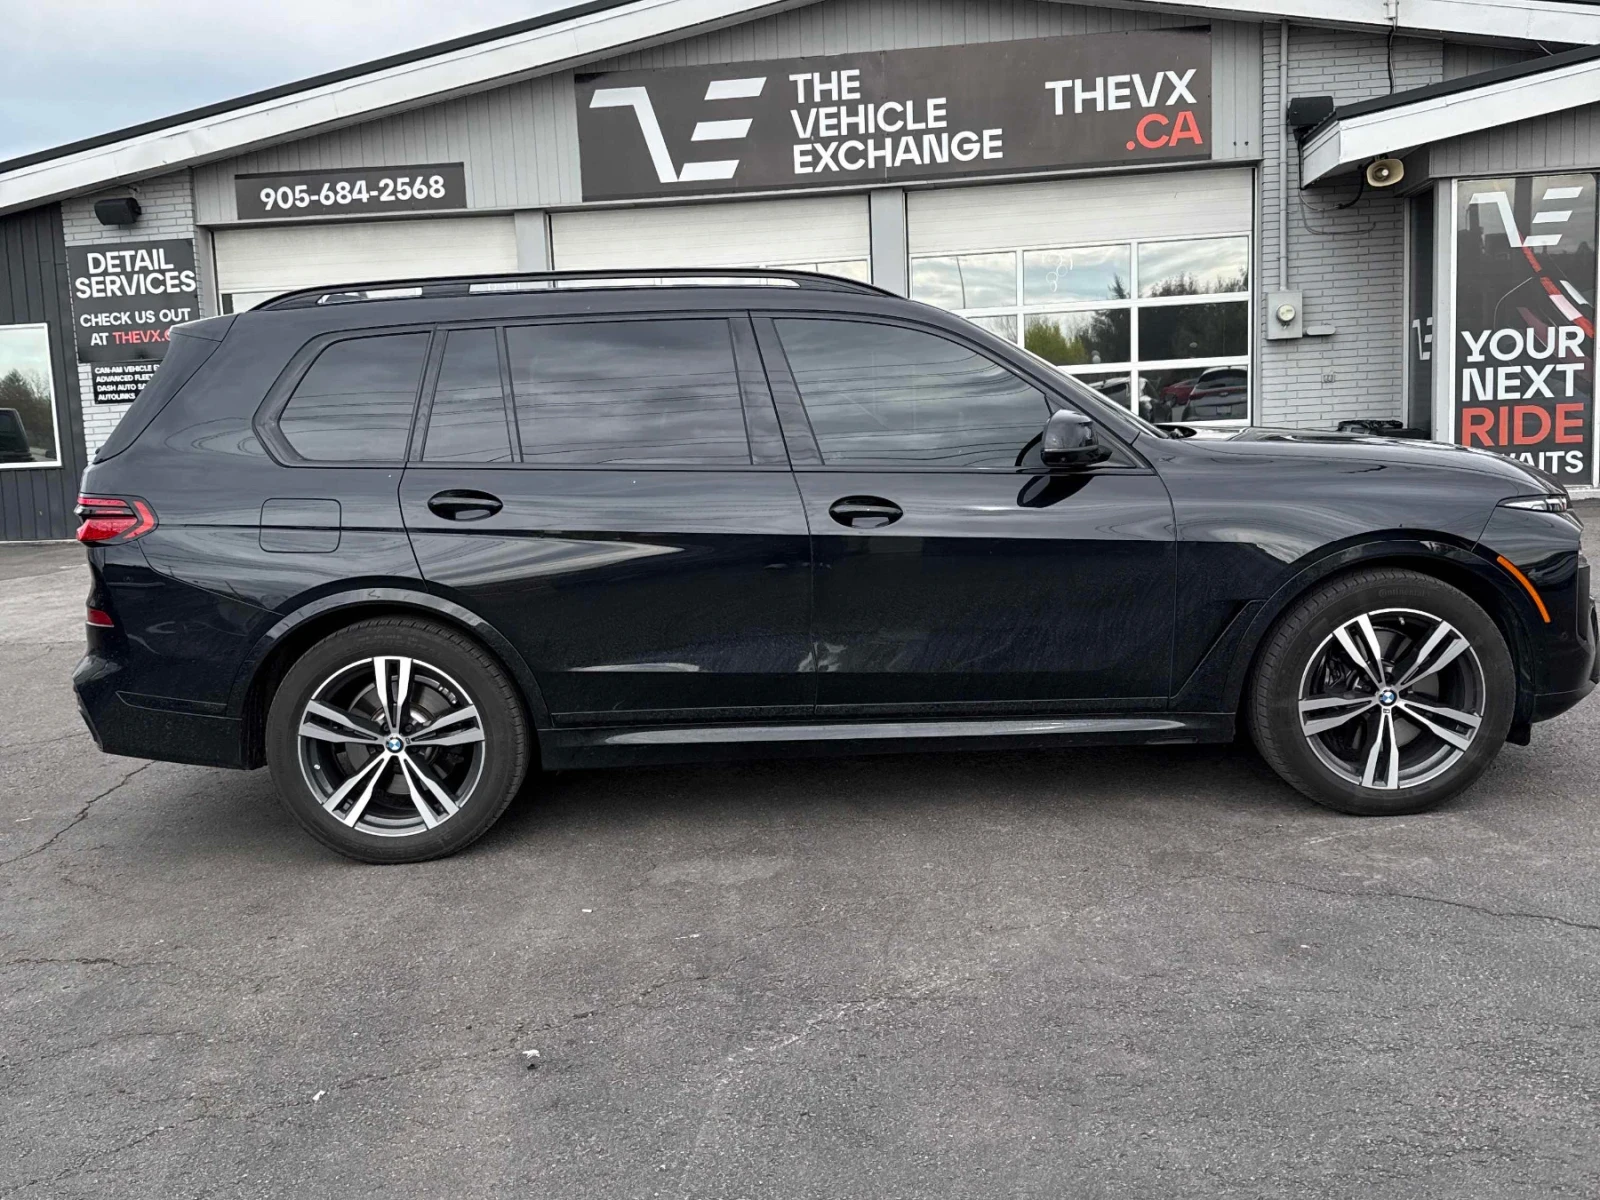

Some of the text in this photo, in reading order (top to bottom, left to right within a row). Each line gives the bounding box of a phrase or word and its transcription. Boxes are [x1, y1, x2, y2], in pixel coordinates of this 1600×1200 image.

[789, 69, 861, 104] THE
[1044, 69, 1197, 116] THEVX
[790, 97, 947, 140] VEHICLE
[1126, 111, 1203, 151] .CA
[793, 128, 1003, 174] EXCHANGE
[260, 175, 446, 211] 905-684-2568
[87, 248, 174, 275] DETAIL
[75, 270, 196, 299] SERVICES
[80, 308, 191, 327] CHECK US OUT
[90, 329, 171, 346] AT THEVX.C
[1460, 325, 1585, 363] YOUR
[95, 374, 134, 383] ADVANCED
[123, 364, 152, 373] VEHICLE
[1462, 363, 1585, 402] NEXT
[97, 384, 116, 392] DASH
[117, 383, 137, 391] AUTO
[97, 392, 136, 401] AUTOLINKS
[1461, 402, 1585, 447] RIDE
[1502, 450, 1584, 474] AITS
